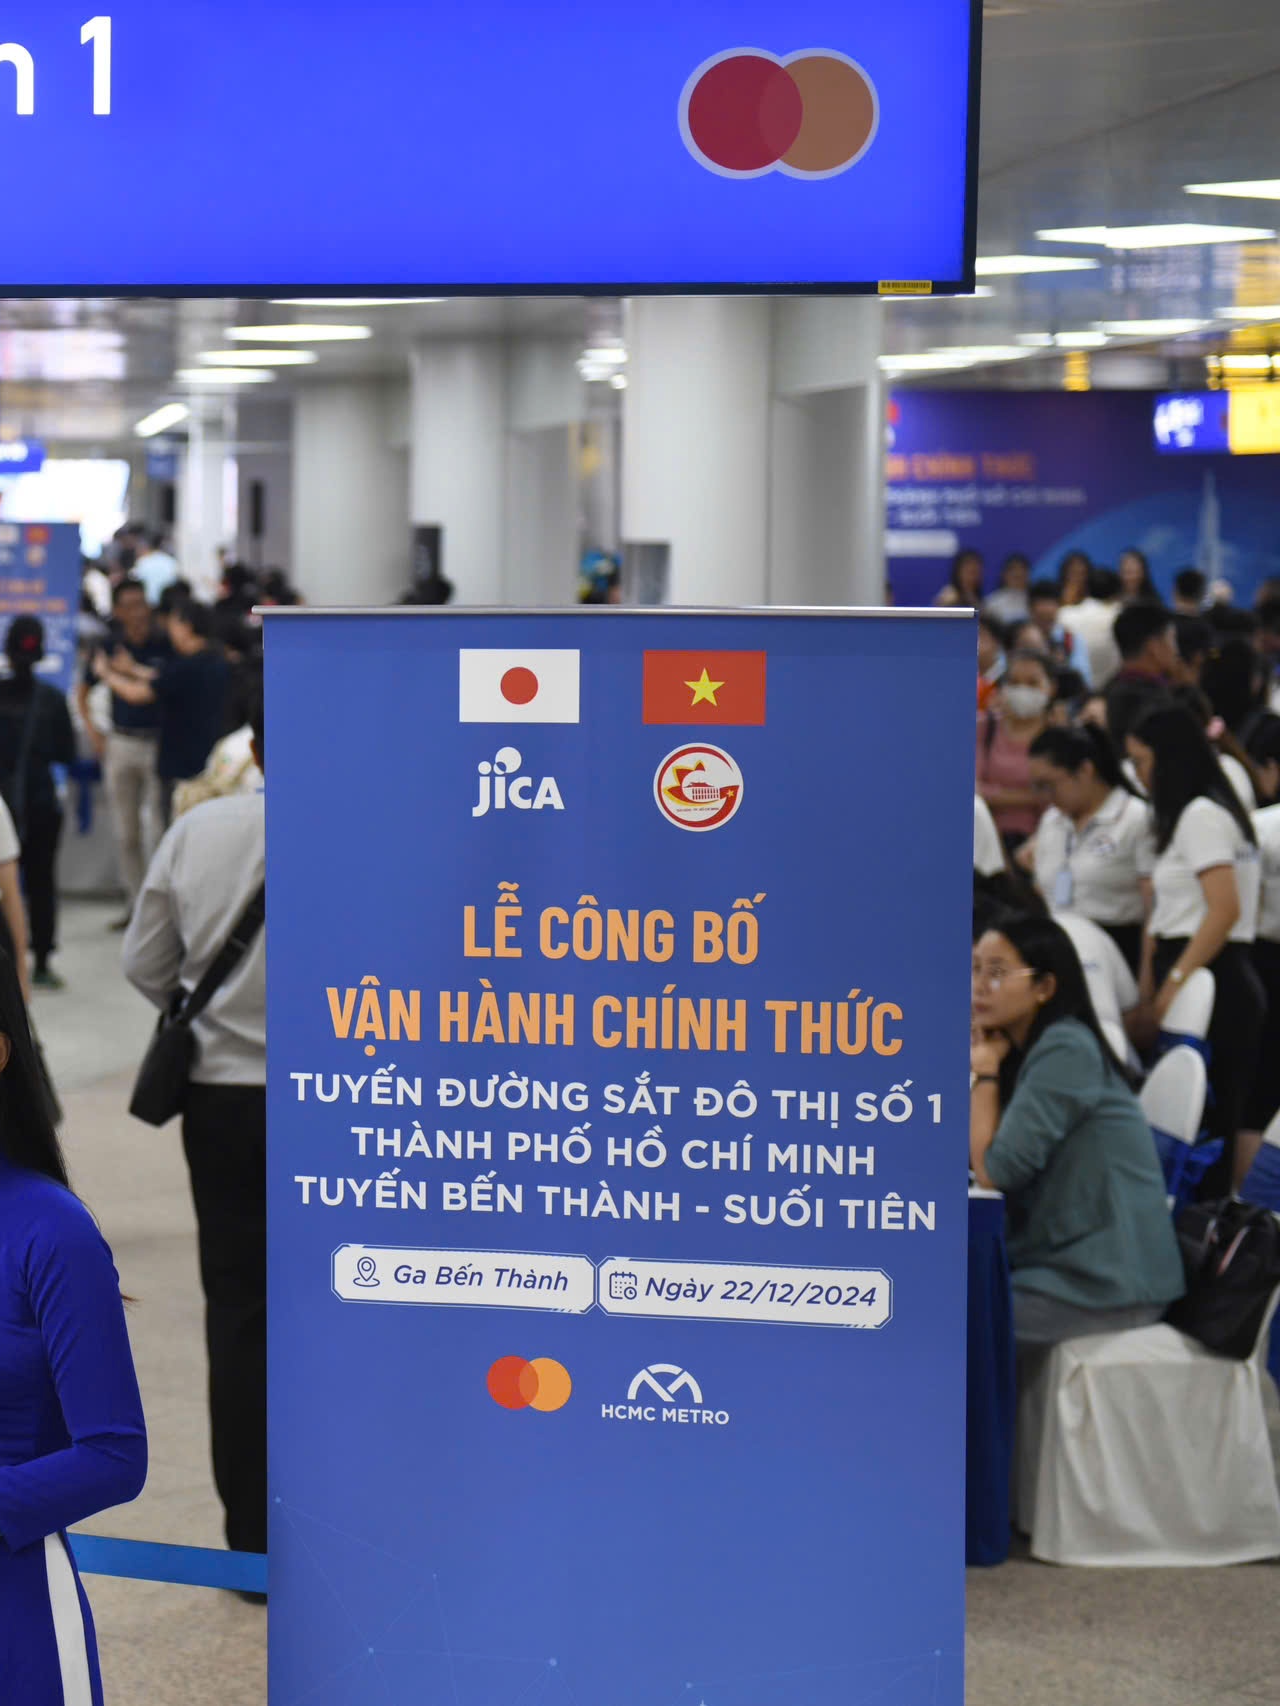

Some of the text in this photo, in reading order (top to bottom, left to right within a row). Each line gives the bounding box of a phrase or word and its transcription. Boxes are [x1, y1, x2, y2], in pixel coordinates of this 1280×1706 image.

[79, 15, 112, 116] 1
[463, 880, 767, 965] LỄ CÔNG BỐ
[325, 974, 904, 1057] VẬN HÀNH CHÍNH THỨC
[289, 1063, 941, 1129] TUYẾN ĐƯỜNG SẮT ĐÔ THỊ SỐ 1
[350, 1119, 875, 1176] THÀNH PHỐ HỒ CHÍ MINH
[294, 1167, 936, 1231] TUYẾN BẾN THÀNH - SUỐI TIÊN
[393, 1262, 569, 1291] Ga Bến Thành
[644, 1277, 877, 1307] Ngày 22/12/2024
[601, 1403, 730, 1425] HCMC METRO
